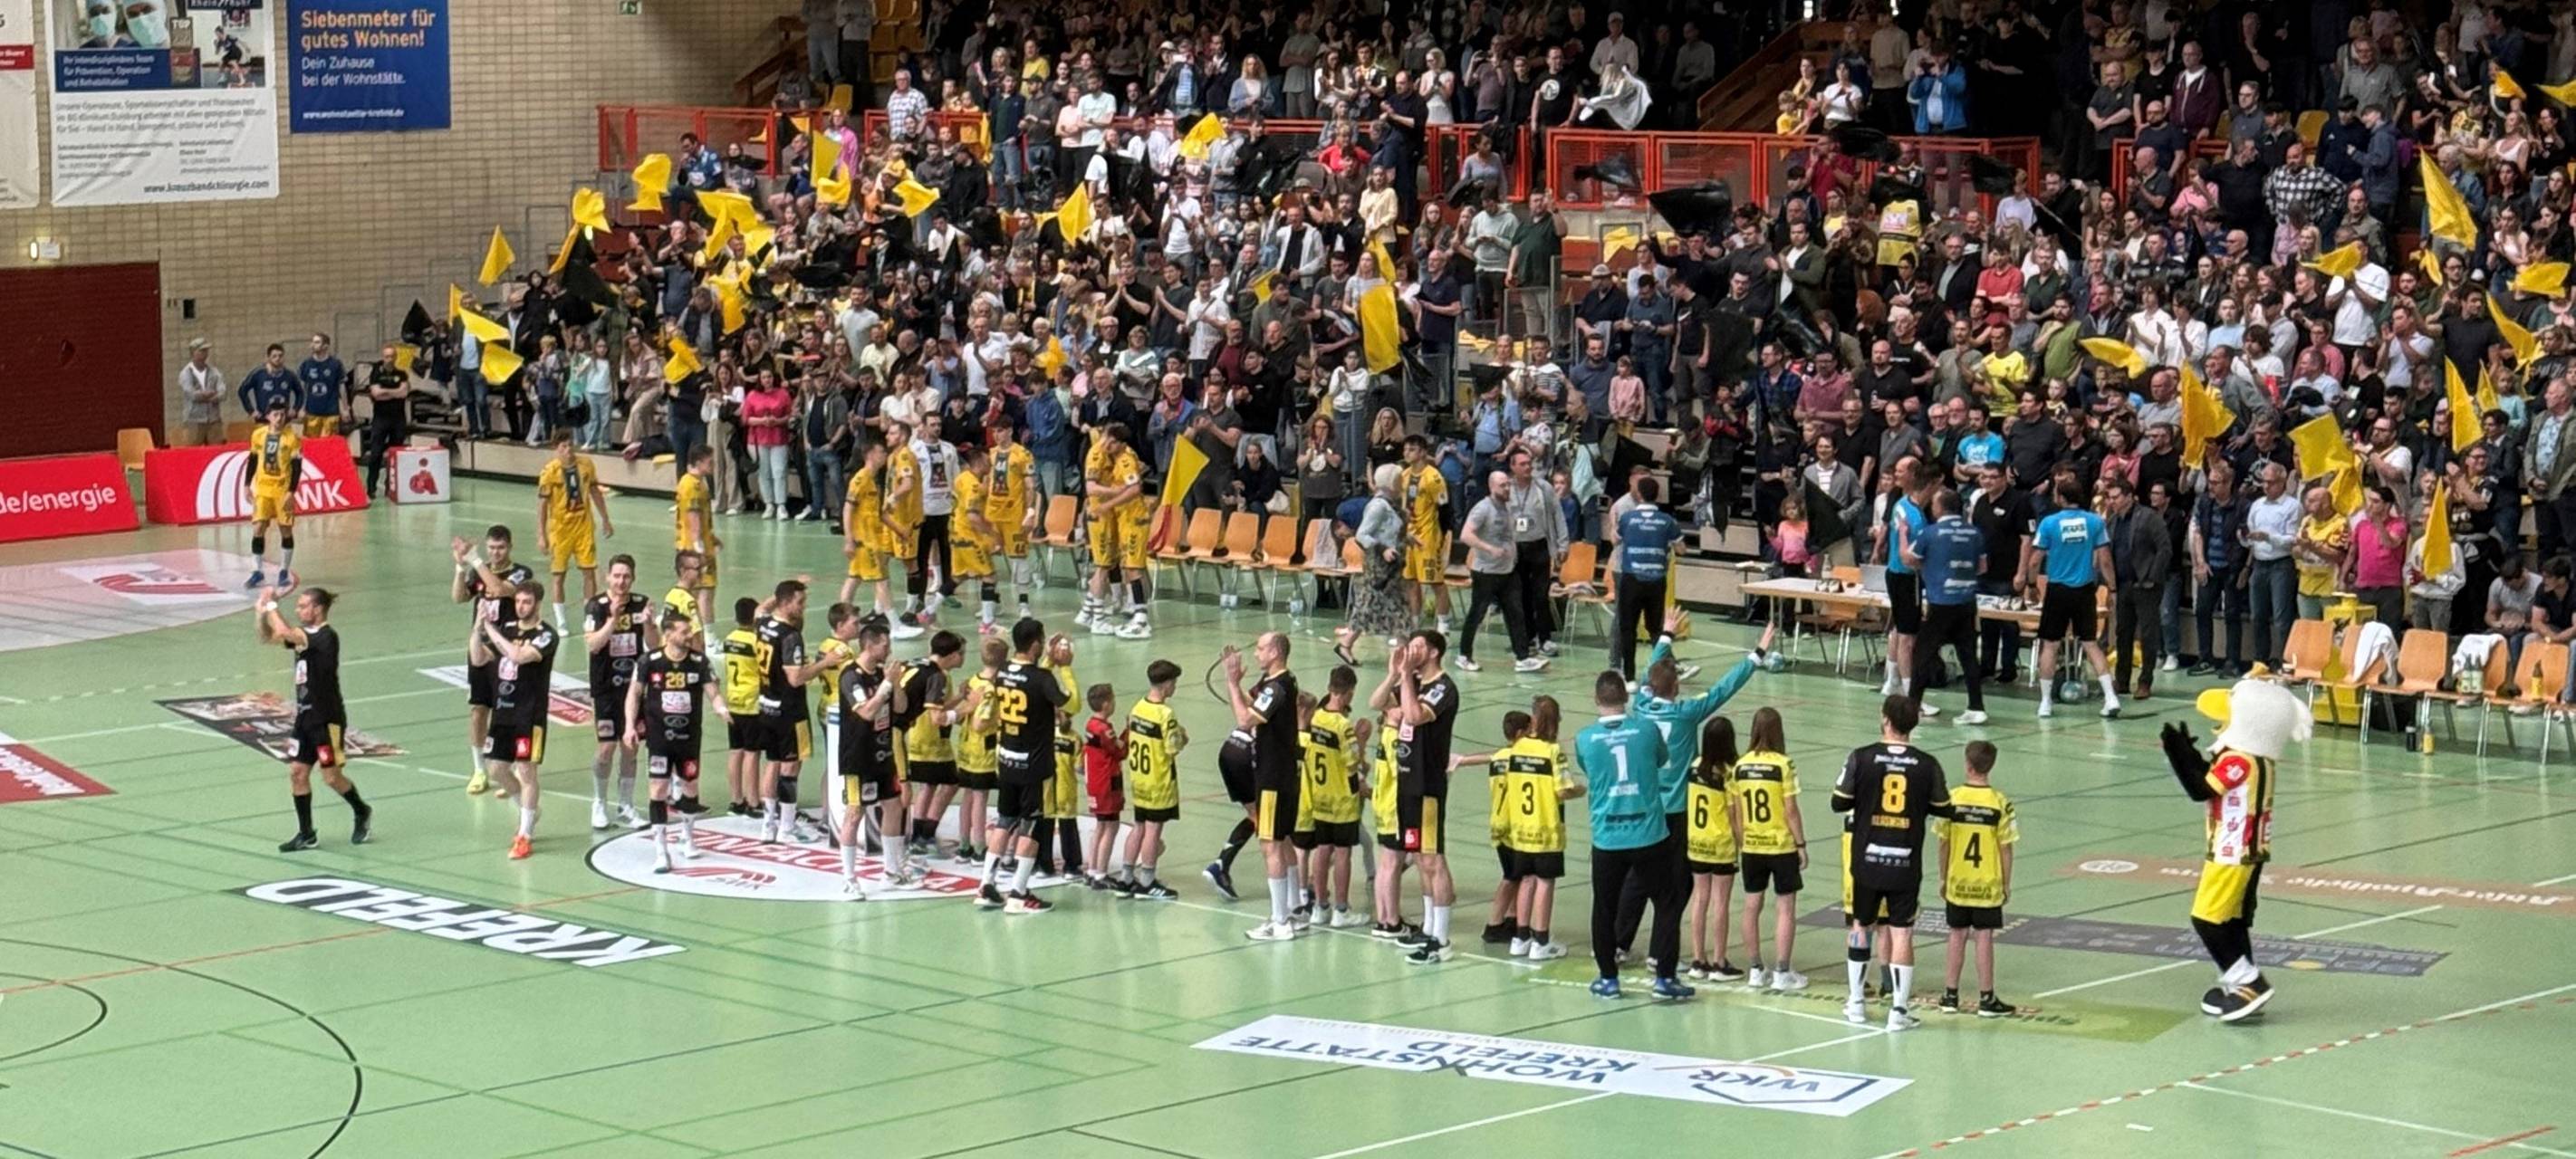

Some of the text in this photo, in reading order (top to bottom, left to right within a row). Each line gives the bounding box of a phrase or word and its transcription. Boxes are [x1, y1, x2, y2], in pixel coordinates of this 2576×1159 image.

[301, 8, 437, 28] Siebenmeter für
[301, 29, 425, 53] gutes Wohnen!
[302, 56, 375, 70] Dein Zuhause
[302, 72, 406, 87] bei der Wohnstätte.
[294, 479, 351, 511] WK
[996, 685, 1028, 725] 22
[1129, 740, 1150, 775] 36
[1314, 752, 1327, 786] 5
[1610, 744, 1629, 782] 1
[1521, 781, 1534, 816] 3
[1743, 788, 1772, 824] 18
[1881, 772, 1908, 814] 8
[1695, 794, 1709, 829] 6
[1963, 831, 1983, 869] 4
[245, 876, 687, 967] KREFELD
[1231, 1035, 1607, 1084] WOHNSTÄTTE
[1407, 1039, 1639, 1072] KREFELD
[1688, 1069, 1820, 1092] WKR
